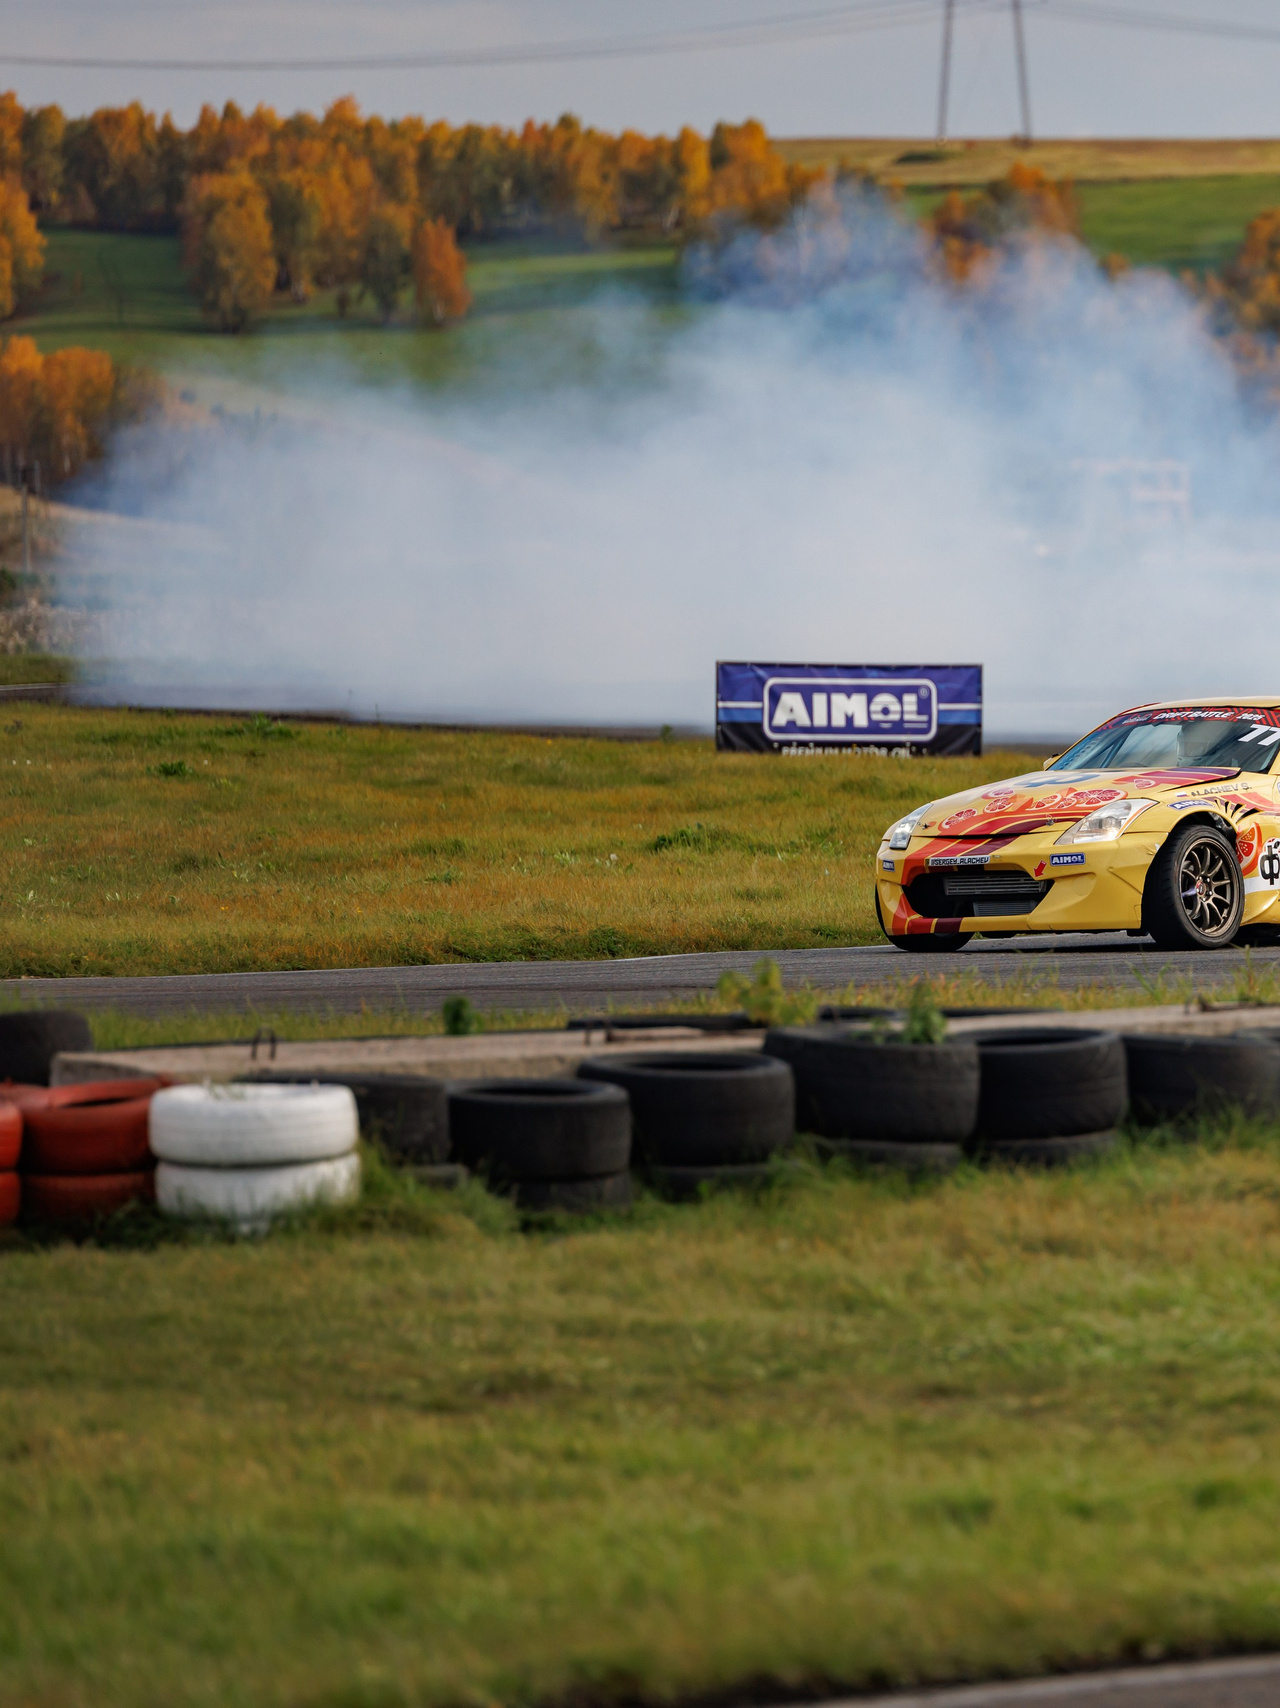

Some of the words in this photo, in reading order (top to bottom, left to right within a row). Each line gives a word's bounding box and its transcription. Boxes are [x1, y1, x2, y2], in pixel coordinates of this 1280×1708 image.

[771, 692, 929, 728] AIMOL
[1153, 711, 1193, 720] DRIFT
[1189, 711, 1235, 719] BATTLE
[1052, 855, 1084, 864] AIMOL
